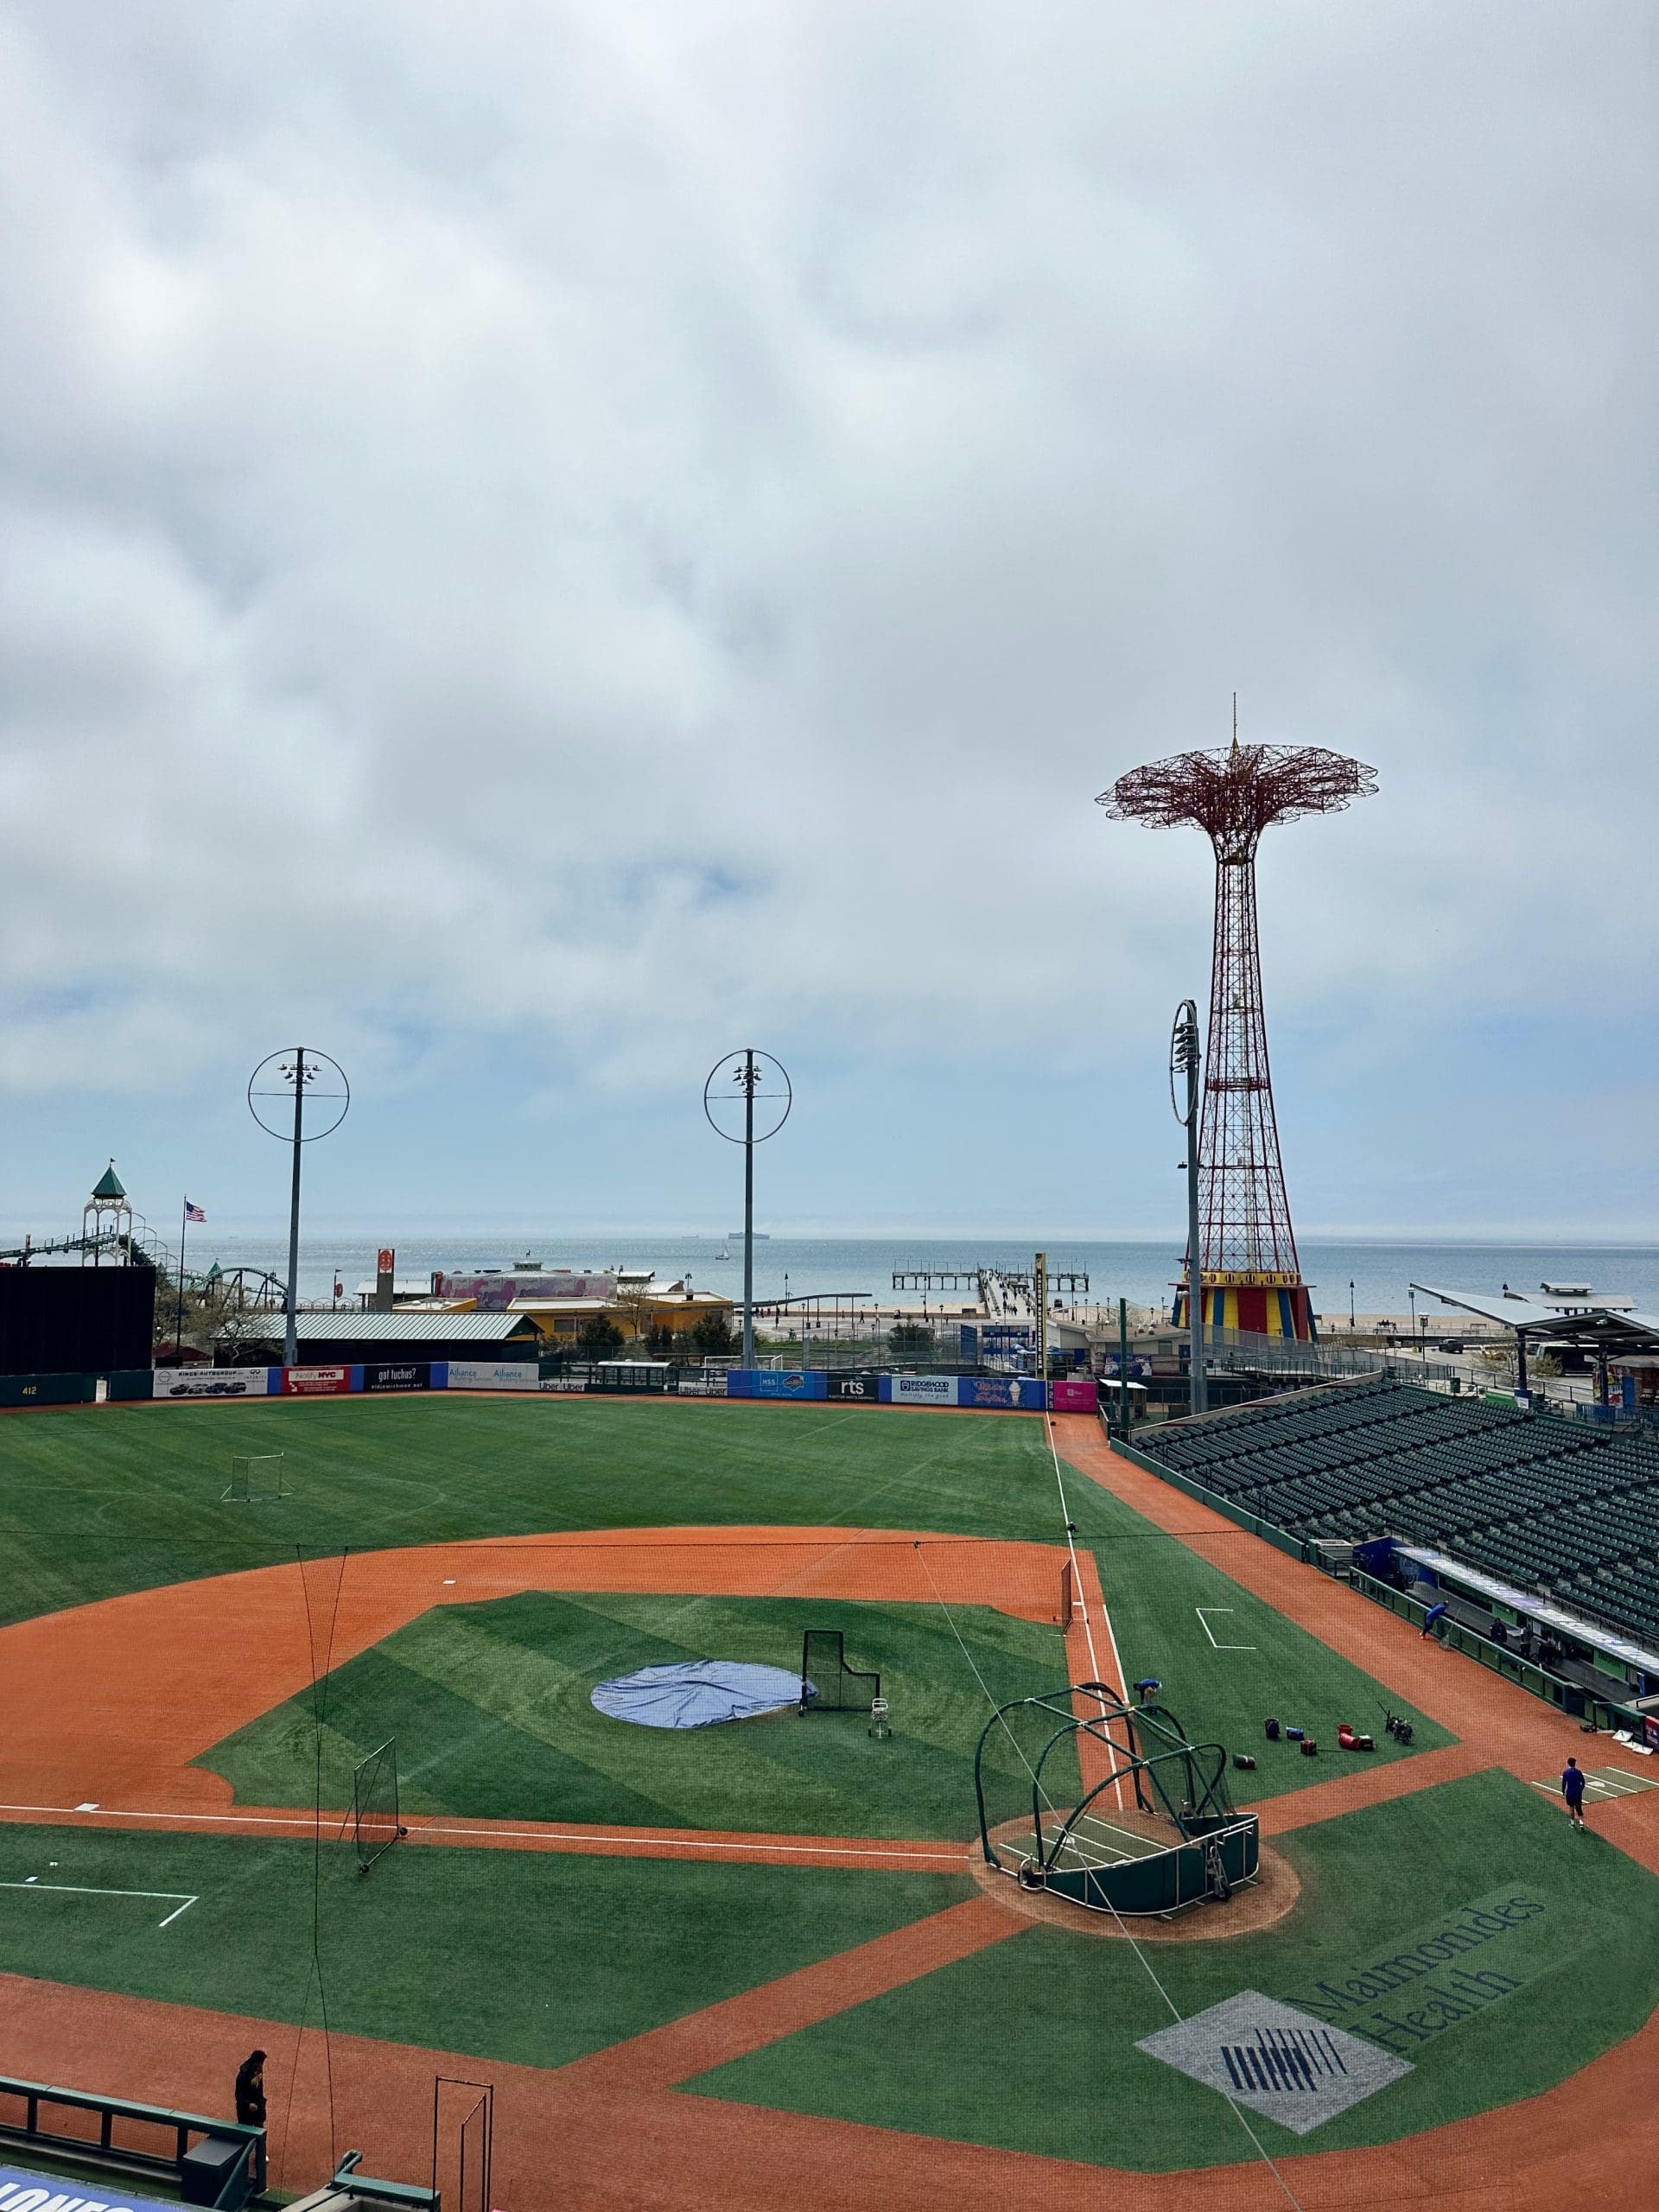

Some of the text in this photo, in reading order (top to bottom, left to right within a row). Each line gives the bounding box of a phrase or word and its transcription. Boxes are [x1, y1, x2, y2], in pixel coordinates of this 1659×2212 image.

[378, 1367, 416, 1382] got tuchus?
[449, 1368, 477, 1377] Alliance
[493, 1369, 522, 1378] Alliance
[22, 1386, 37, 1395] 412
[539, 1382, 559, 1391] Uber
[563, 1382, 583, 1392] Uber
[679, 1386, 702, 1395] Uber
[704, 1386, 727, 1396] Uber
[840, 1380, 865, 1395] rts
[1284, 1897, 1545, 2021] Maimonides
[1348, 1968, 1525, 2053] Health
